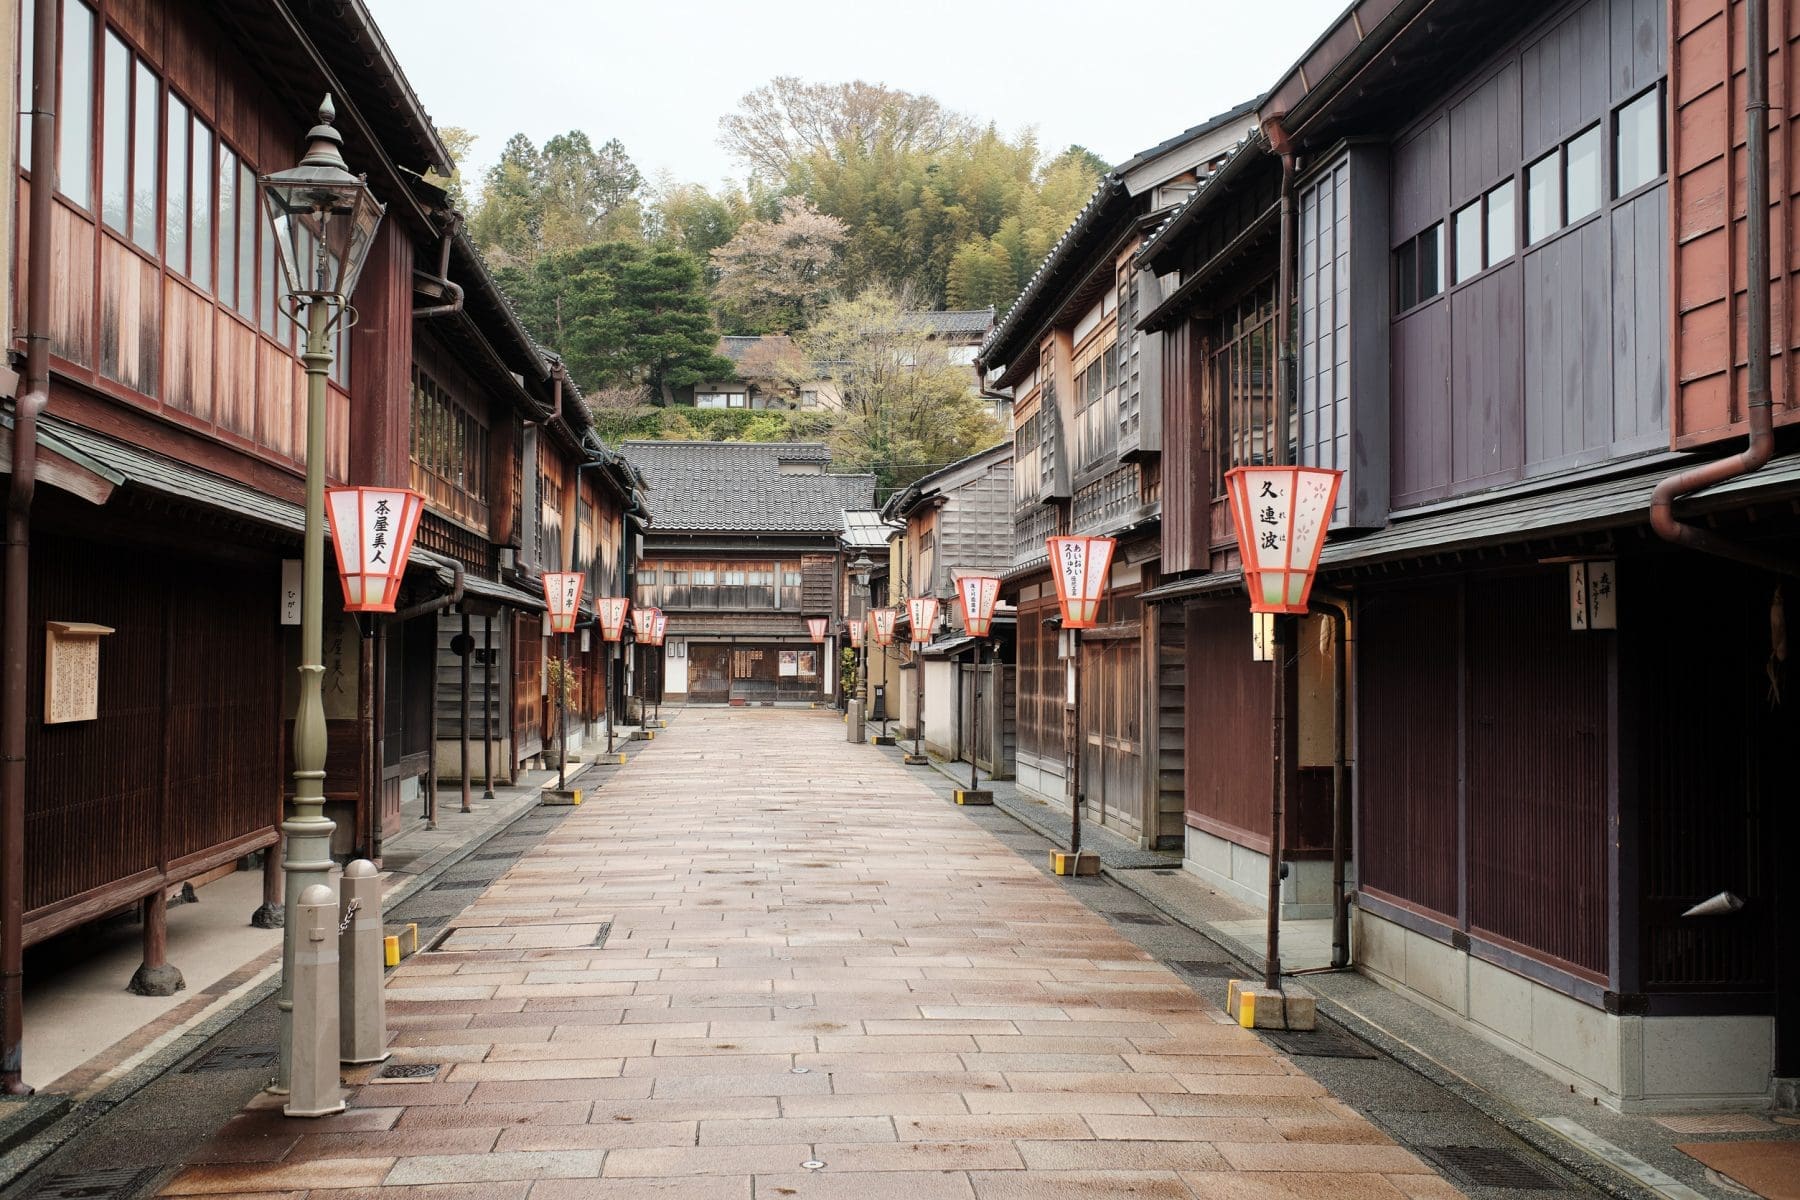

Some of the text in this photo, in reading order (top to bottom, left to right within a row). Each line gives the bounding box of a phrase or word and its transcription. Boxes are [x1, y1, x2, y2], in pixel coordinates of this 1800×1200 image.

[370, 500, 392, 565] 茶屋美人
[1259, 480, 1279, 550] 久連波
[1279, 489, 1287, 542] くれは
[287, 589, 296, 620] ひがし
